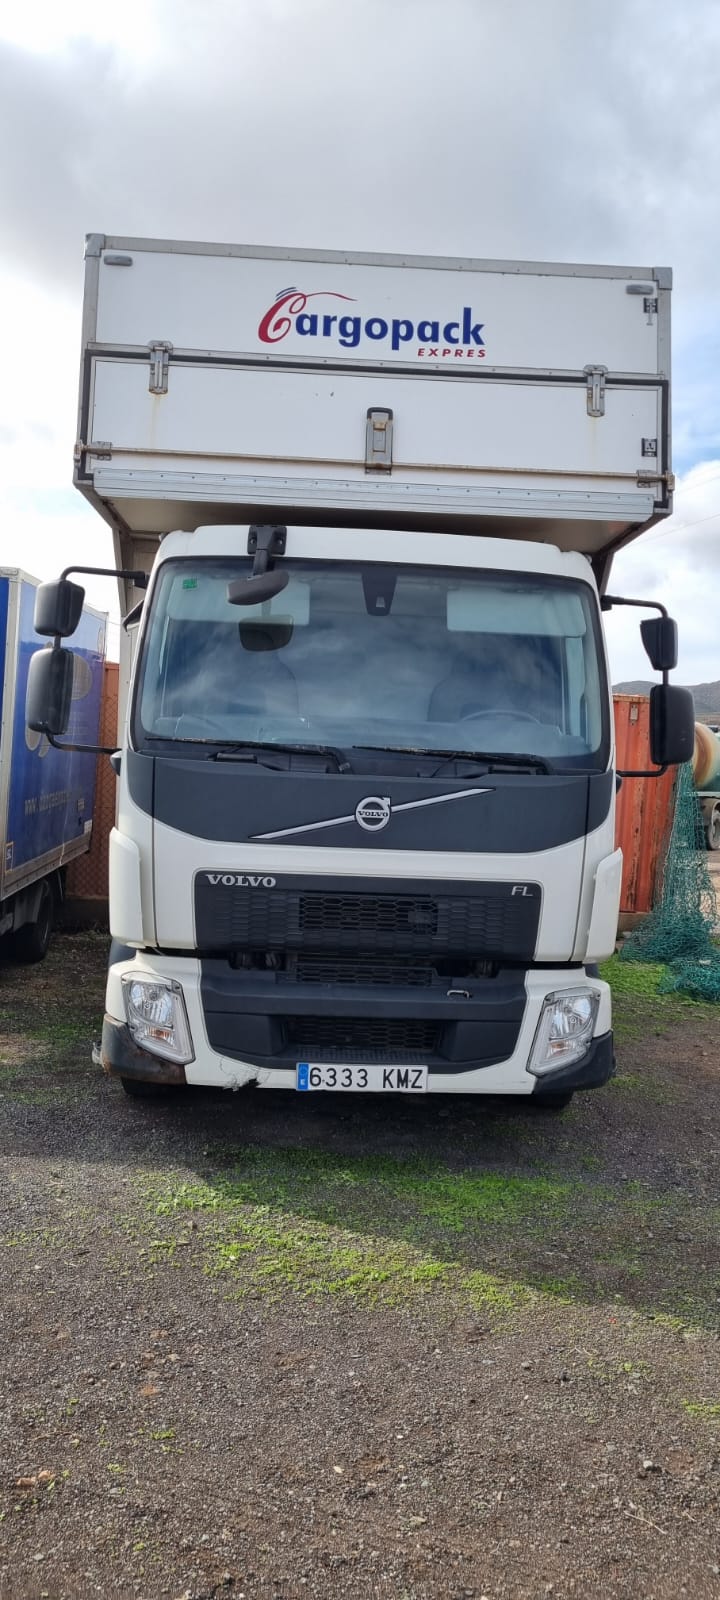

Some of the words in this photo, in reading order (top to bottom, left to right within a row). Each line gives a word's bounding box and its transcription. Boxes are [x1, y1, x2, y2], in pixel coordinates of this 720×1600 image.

[258, 292, 486, 350] Cargopack
[417, 348, 486, 358] EXPRES
[206, 873, 276, 888] VOLVO
[511, 885, 534, 897] FL
[309, 1067, 368, 1088] 6333
[382, 1068, 423, 1089] KMZ
